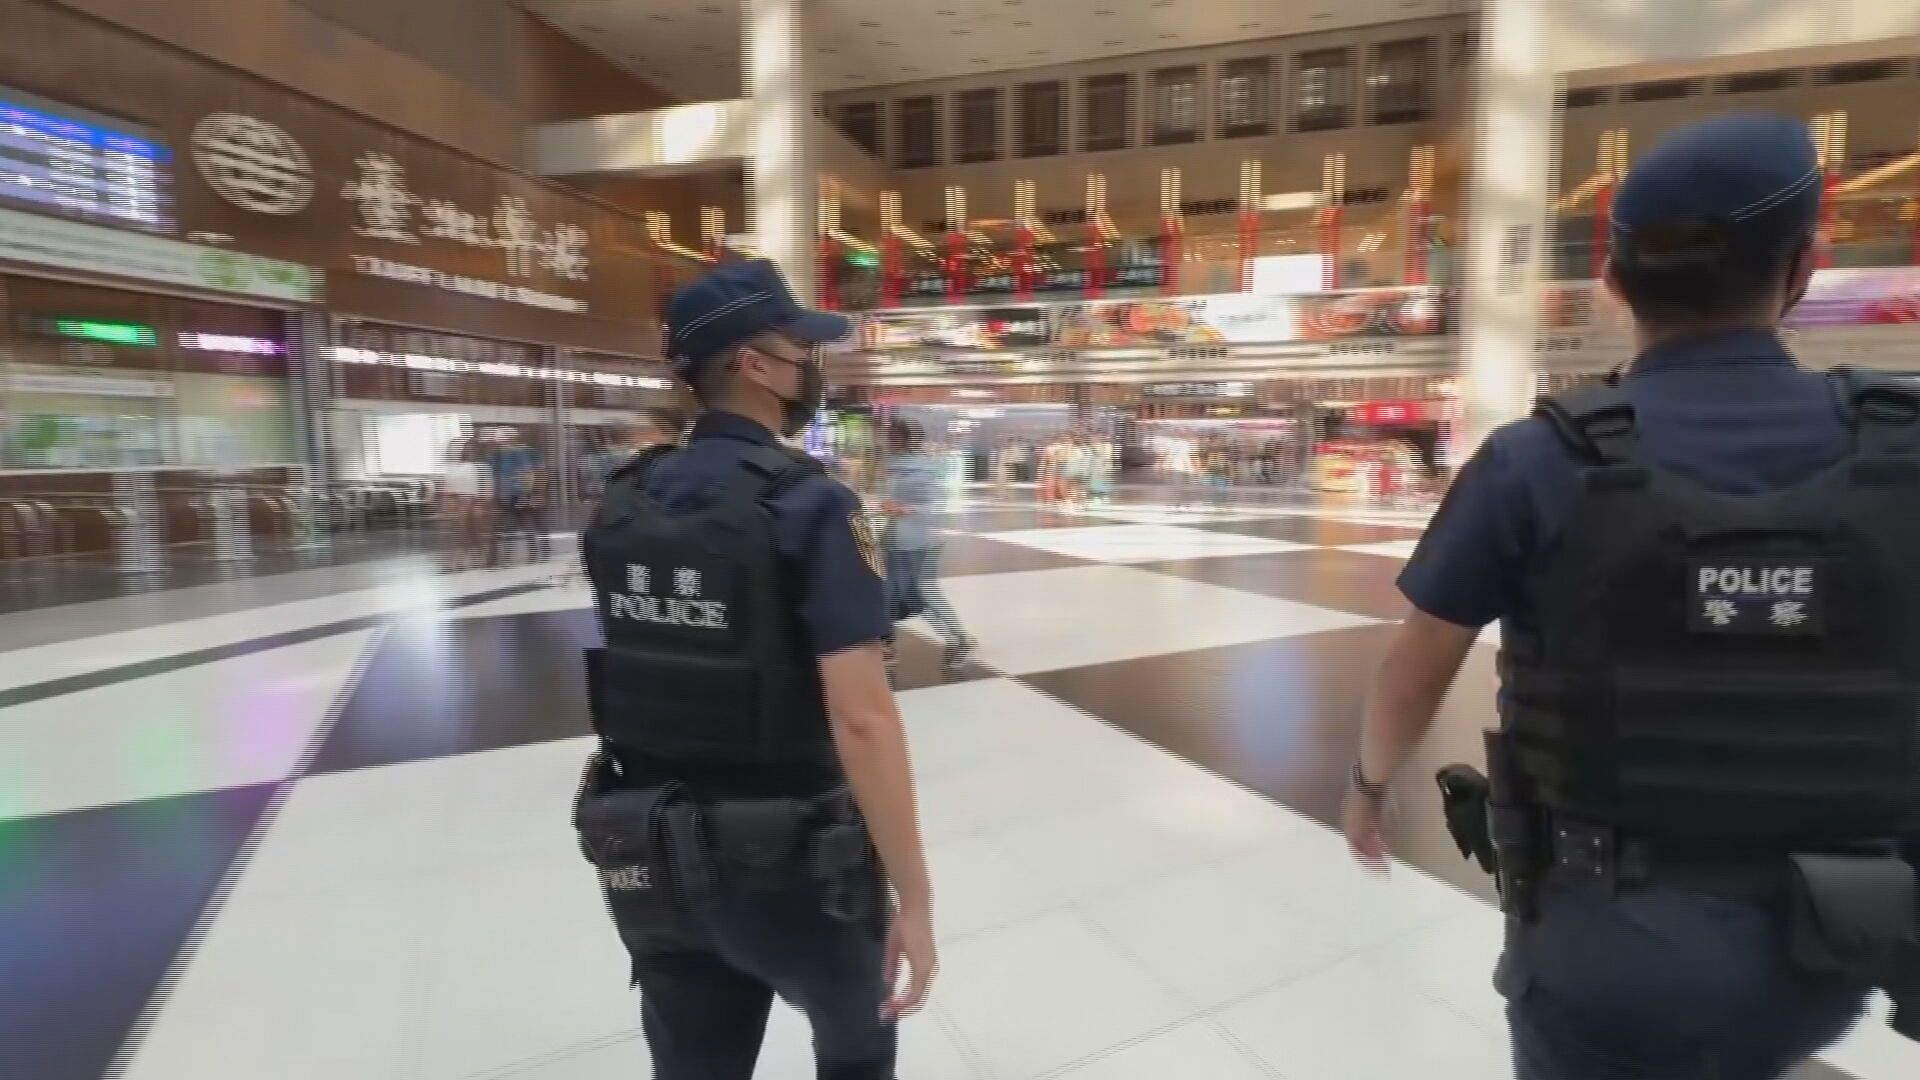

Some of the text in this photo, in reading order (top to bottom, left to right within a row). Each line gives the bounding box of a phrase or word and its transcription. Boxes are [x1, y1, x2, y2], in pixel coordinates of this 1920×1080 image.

[626, 562, 701, 597] 警察
[1698, 567, 1814, 594] POLICE
[608, 592, 728, 630] POLICE
[1701, 600, 1809, 627] 警察
